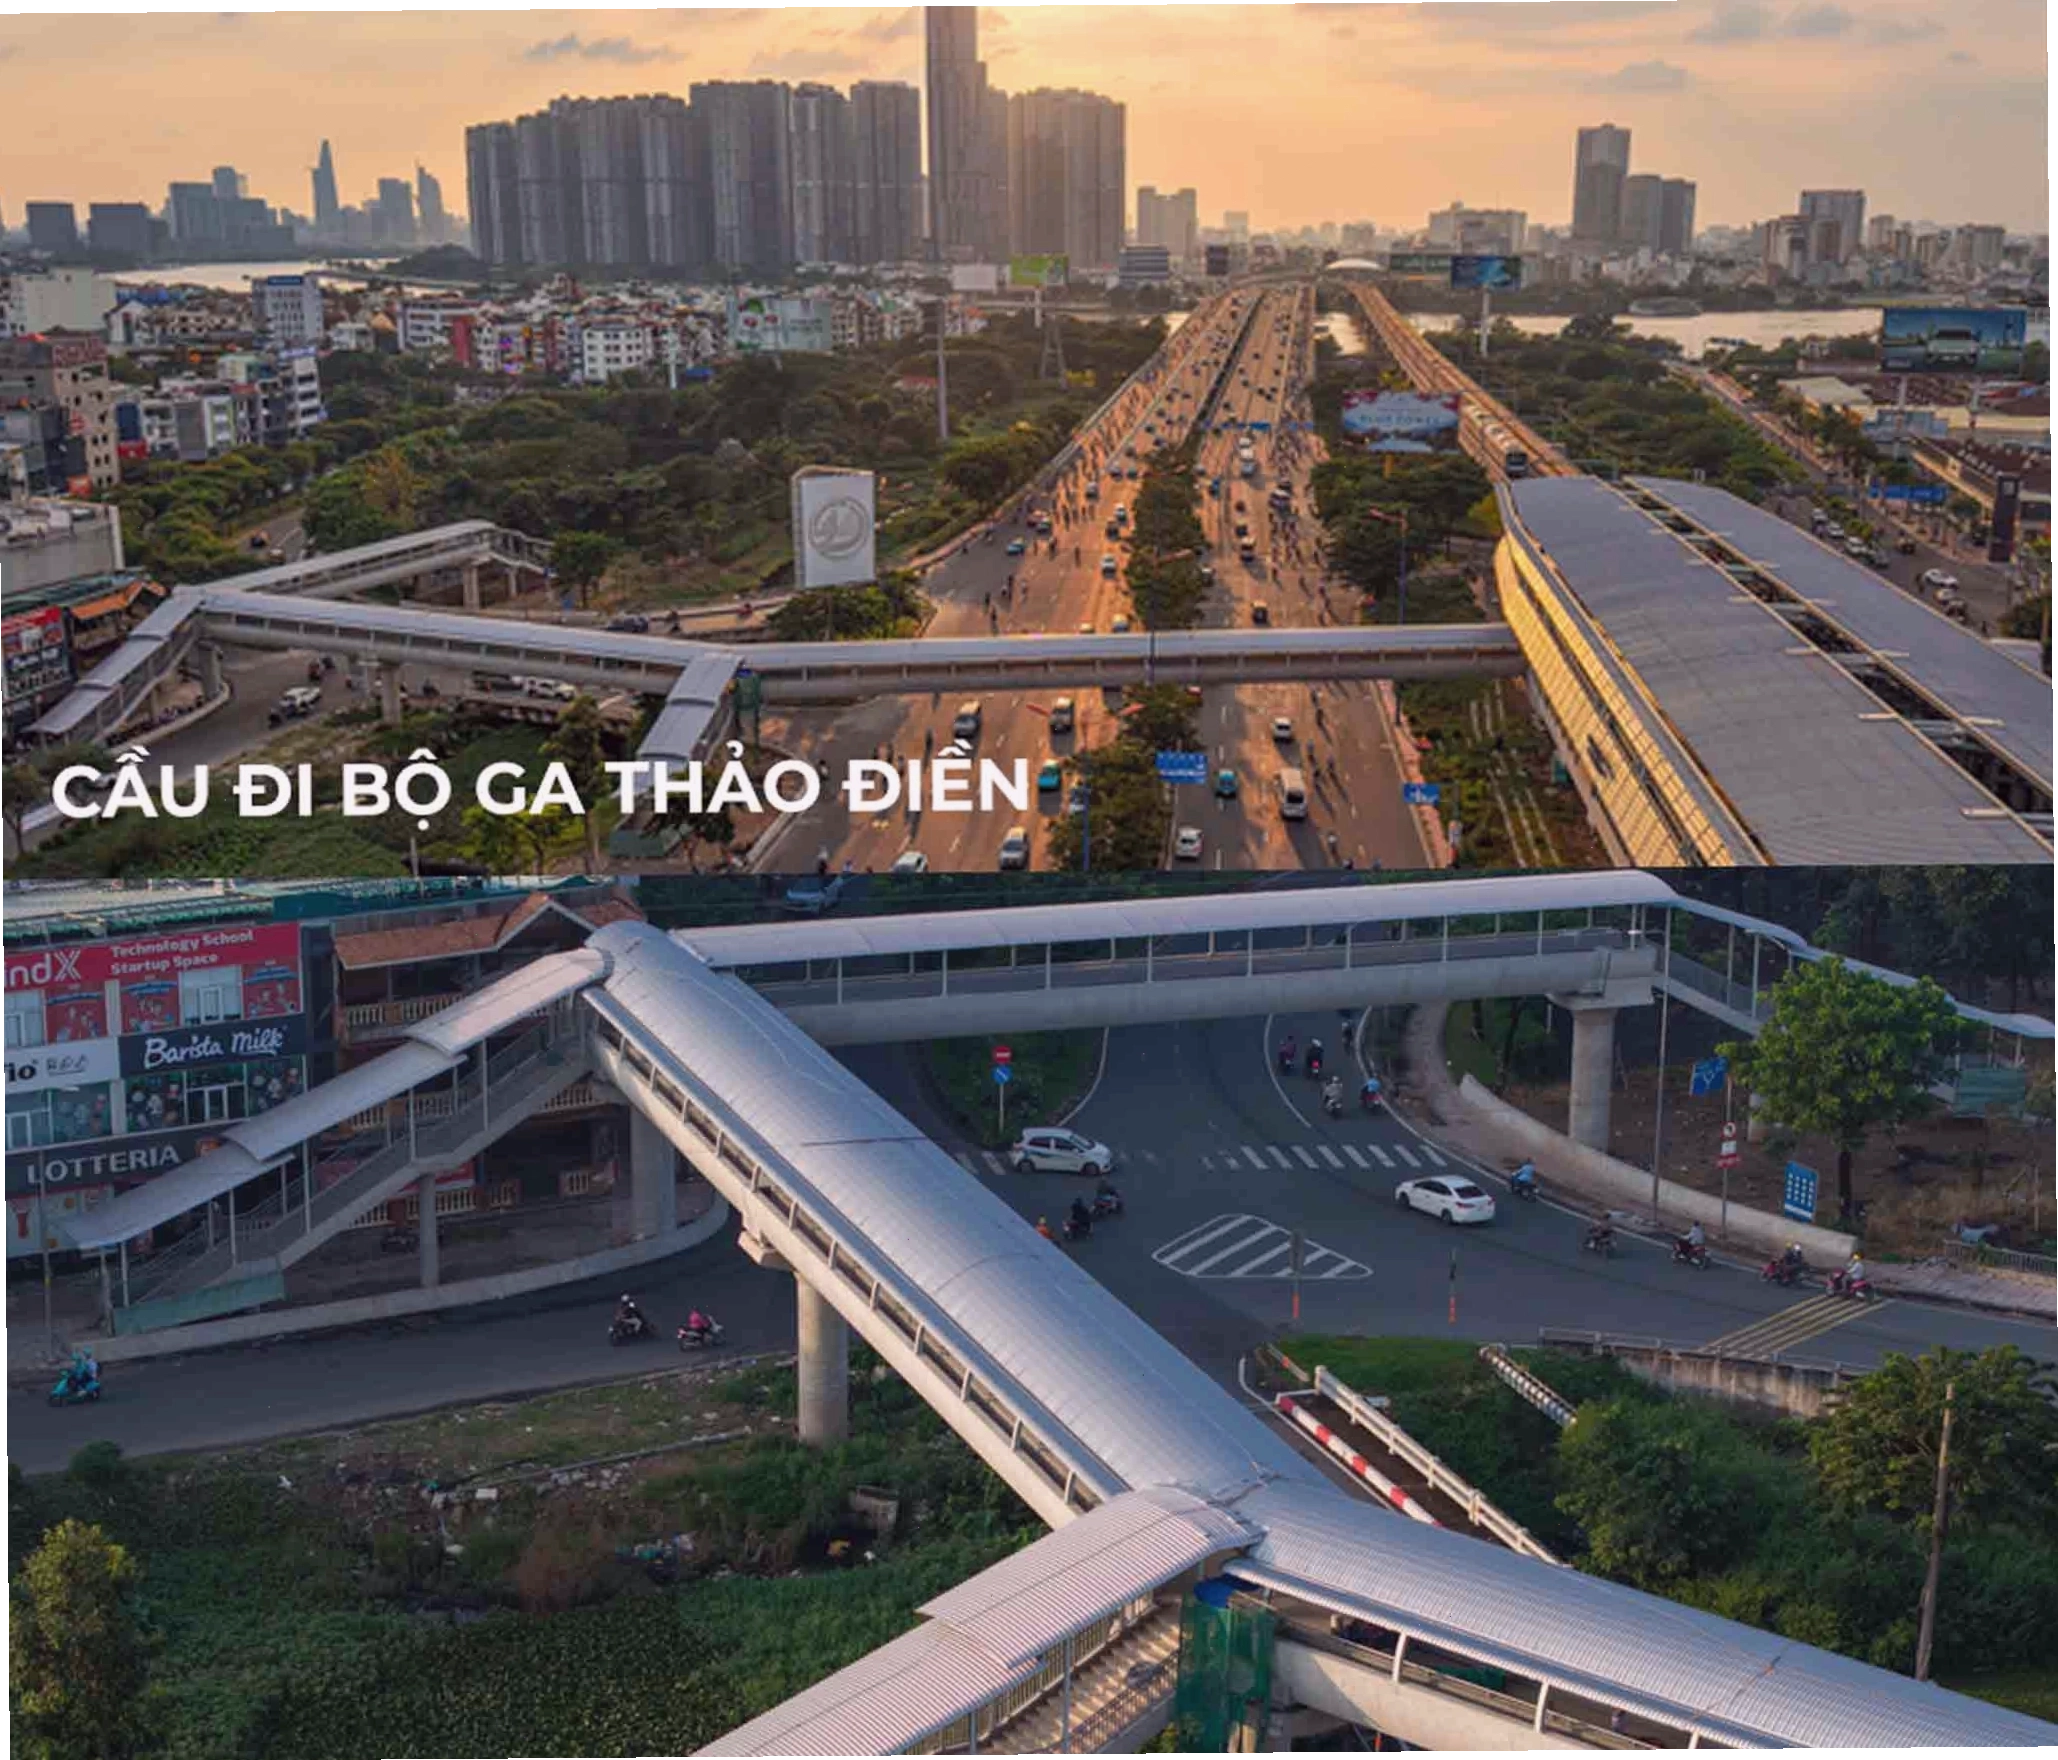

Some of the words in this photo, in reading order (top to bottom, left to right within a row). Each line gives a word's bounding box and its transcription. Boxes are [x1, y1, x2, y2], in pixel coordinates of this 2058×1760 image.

[110, 938, 200, 958] Technology
[202, 930, 253, 947] School
[110, 957, 170, 975] Startup
[172, 953, 219, 970] Space
[144, 1033, 224, 1069] Barista
[231, 1027, 284, 1056] Milk
[4, 1060, 36, 1083] io
[27, 1145, 182, 1184] LOTTERIA
